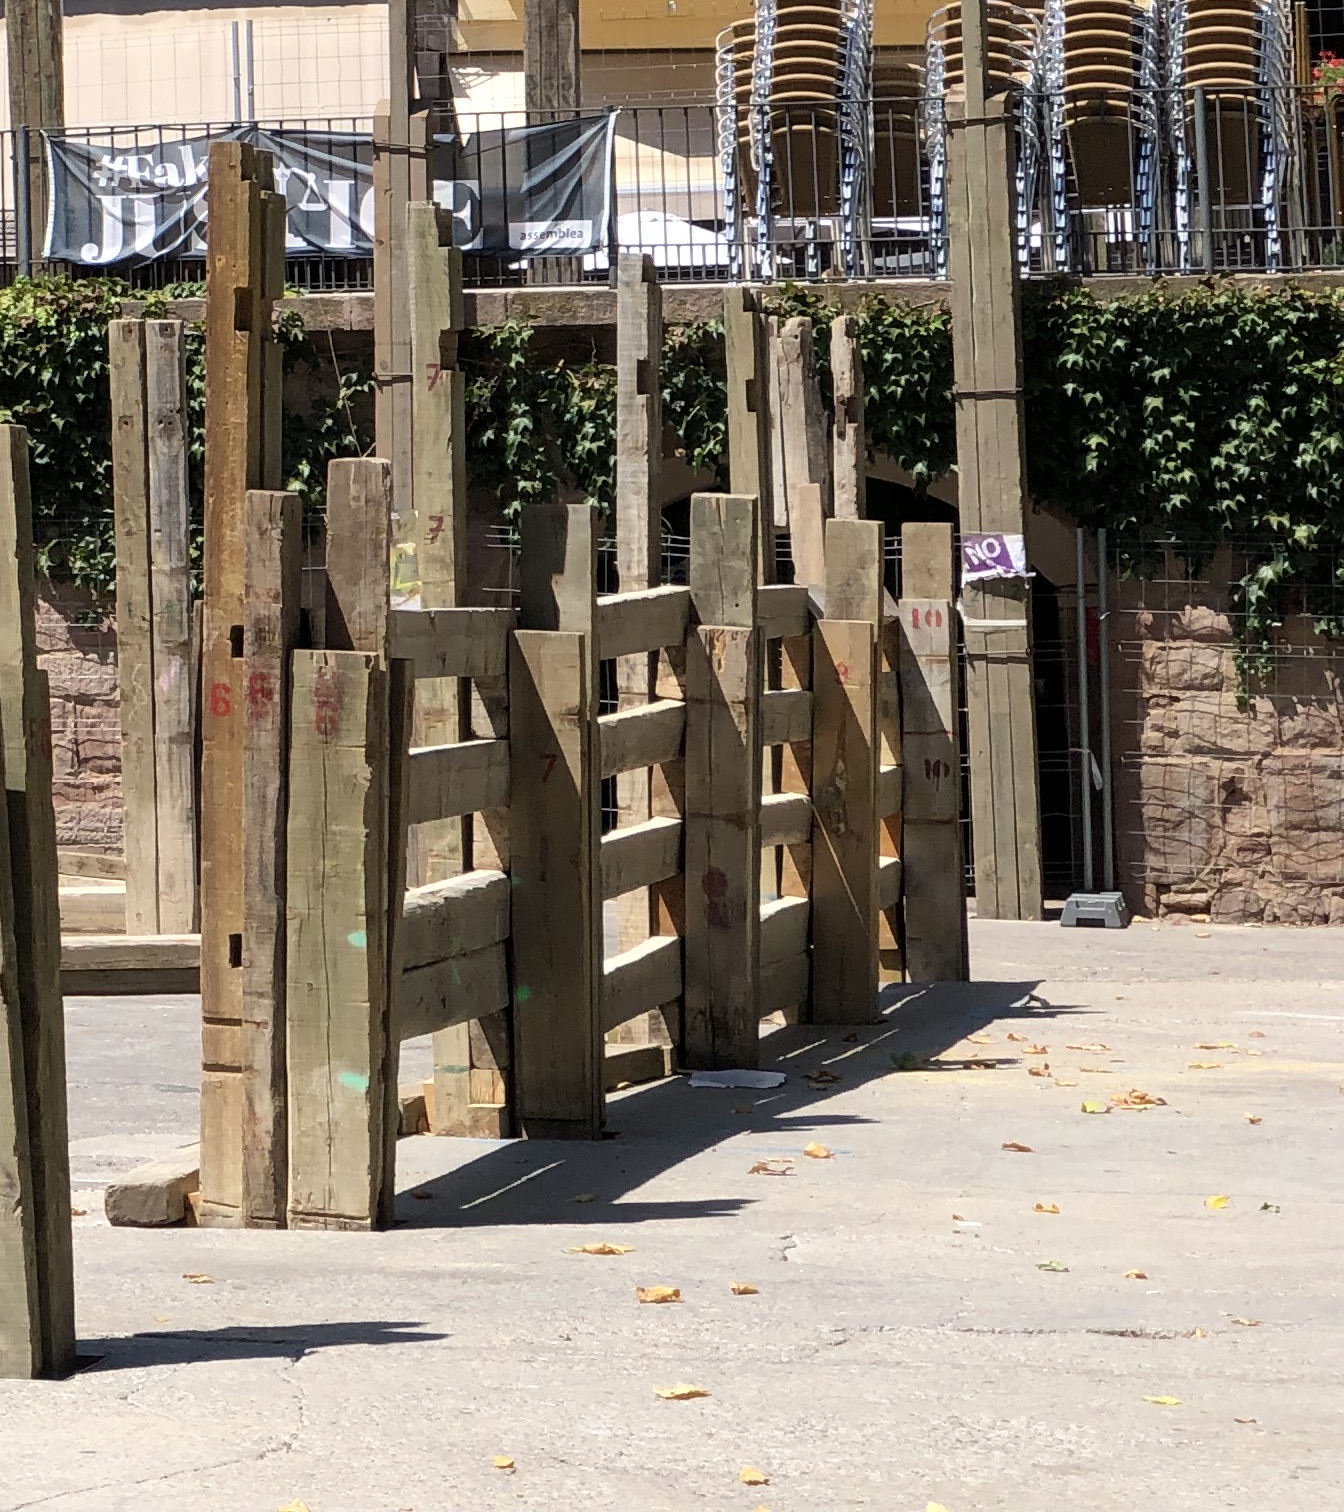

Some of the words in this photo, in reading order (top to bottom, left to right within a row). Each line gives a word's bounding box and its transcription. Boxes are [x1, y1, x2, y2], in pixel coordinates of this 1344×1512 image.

[92, 144, 209, 190] #Fak
[519, 227, 584, 241] assemblea
[964, 537, 1002, 566] NO
[910, 607, 943, 630] 10
[209, 682, 232, 717] 6
[538, 753, 557, 783] 7
